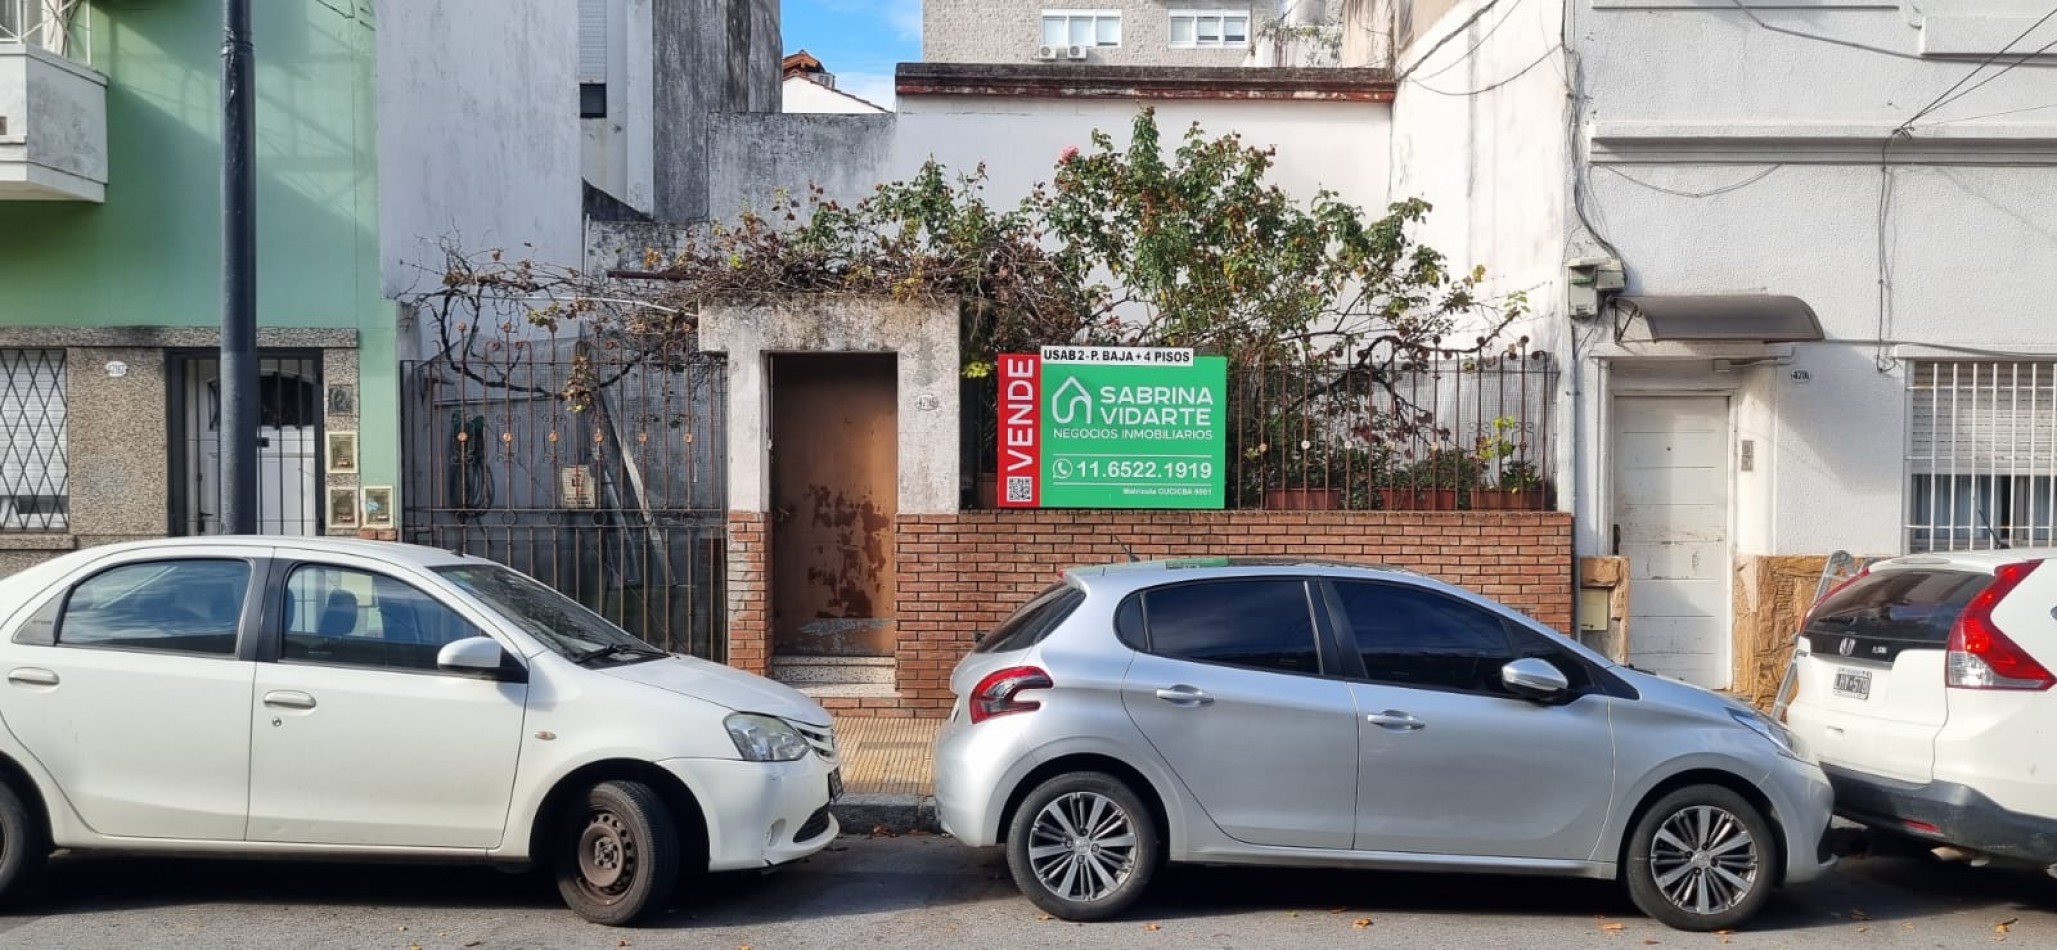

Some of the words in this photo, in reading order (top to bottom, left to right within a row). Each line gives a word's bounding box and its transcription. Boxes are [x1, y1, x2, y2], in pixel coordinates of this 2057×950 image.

[1102, 350, 1134, 362] BAJA
[1143, 351, 1151, 361] 4
[1154, 351, 1190, 363] PISOS
[1100, 386, 1214, 405] SABRINA
[1007, 359, 1034, 472] VENDE
[1100, 407, 1212, 426] VIDARTE
[1053, 427, 1118, 439] NEGOCIOS
[1121, 428, 1213, 440] INMOBILIARIOS
[1076, 460, 1213, 479] 11.6522.1919
